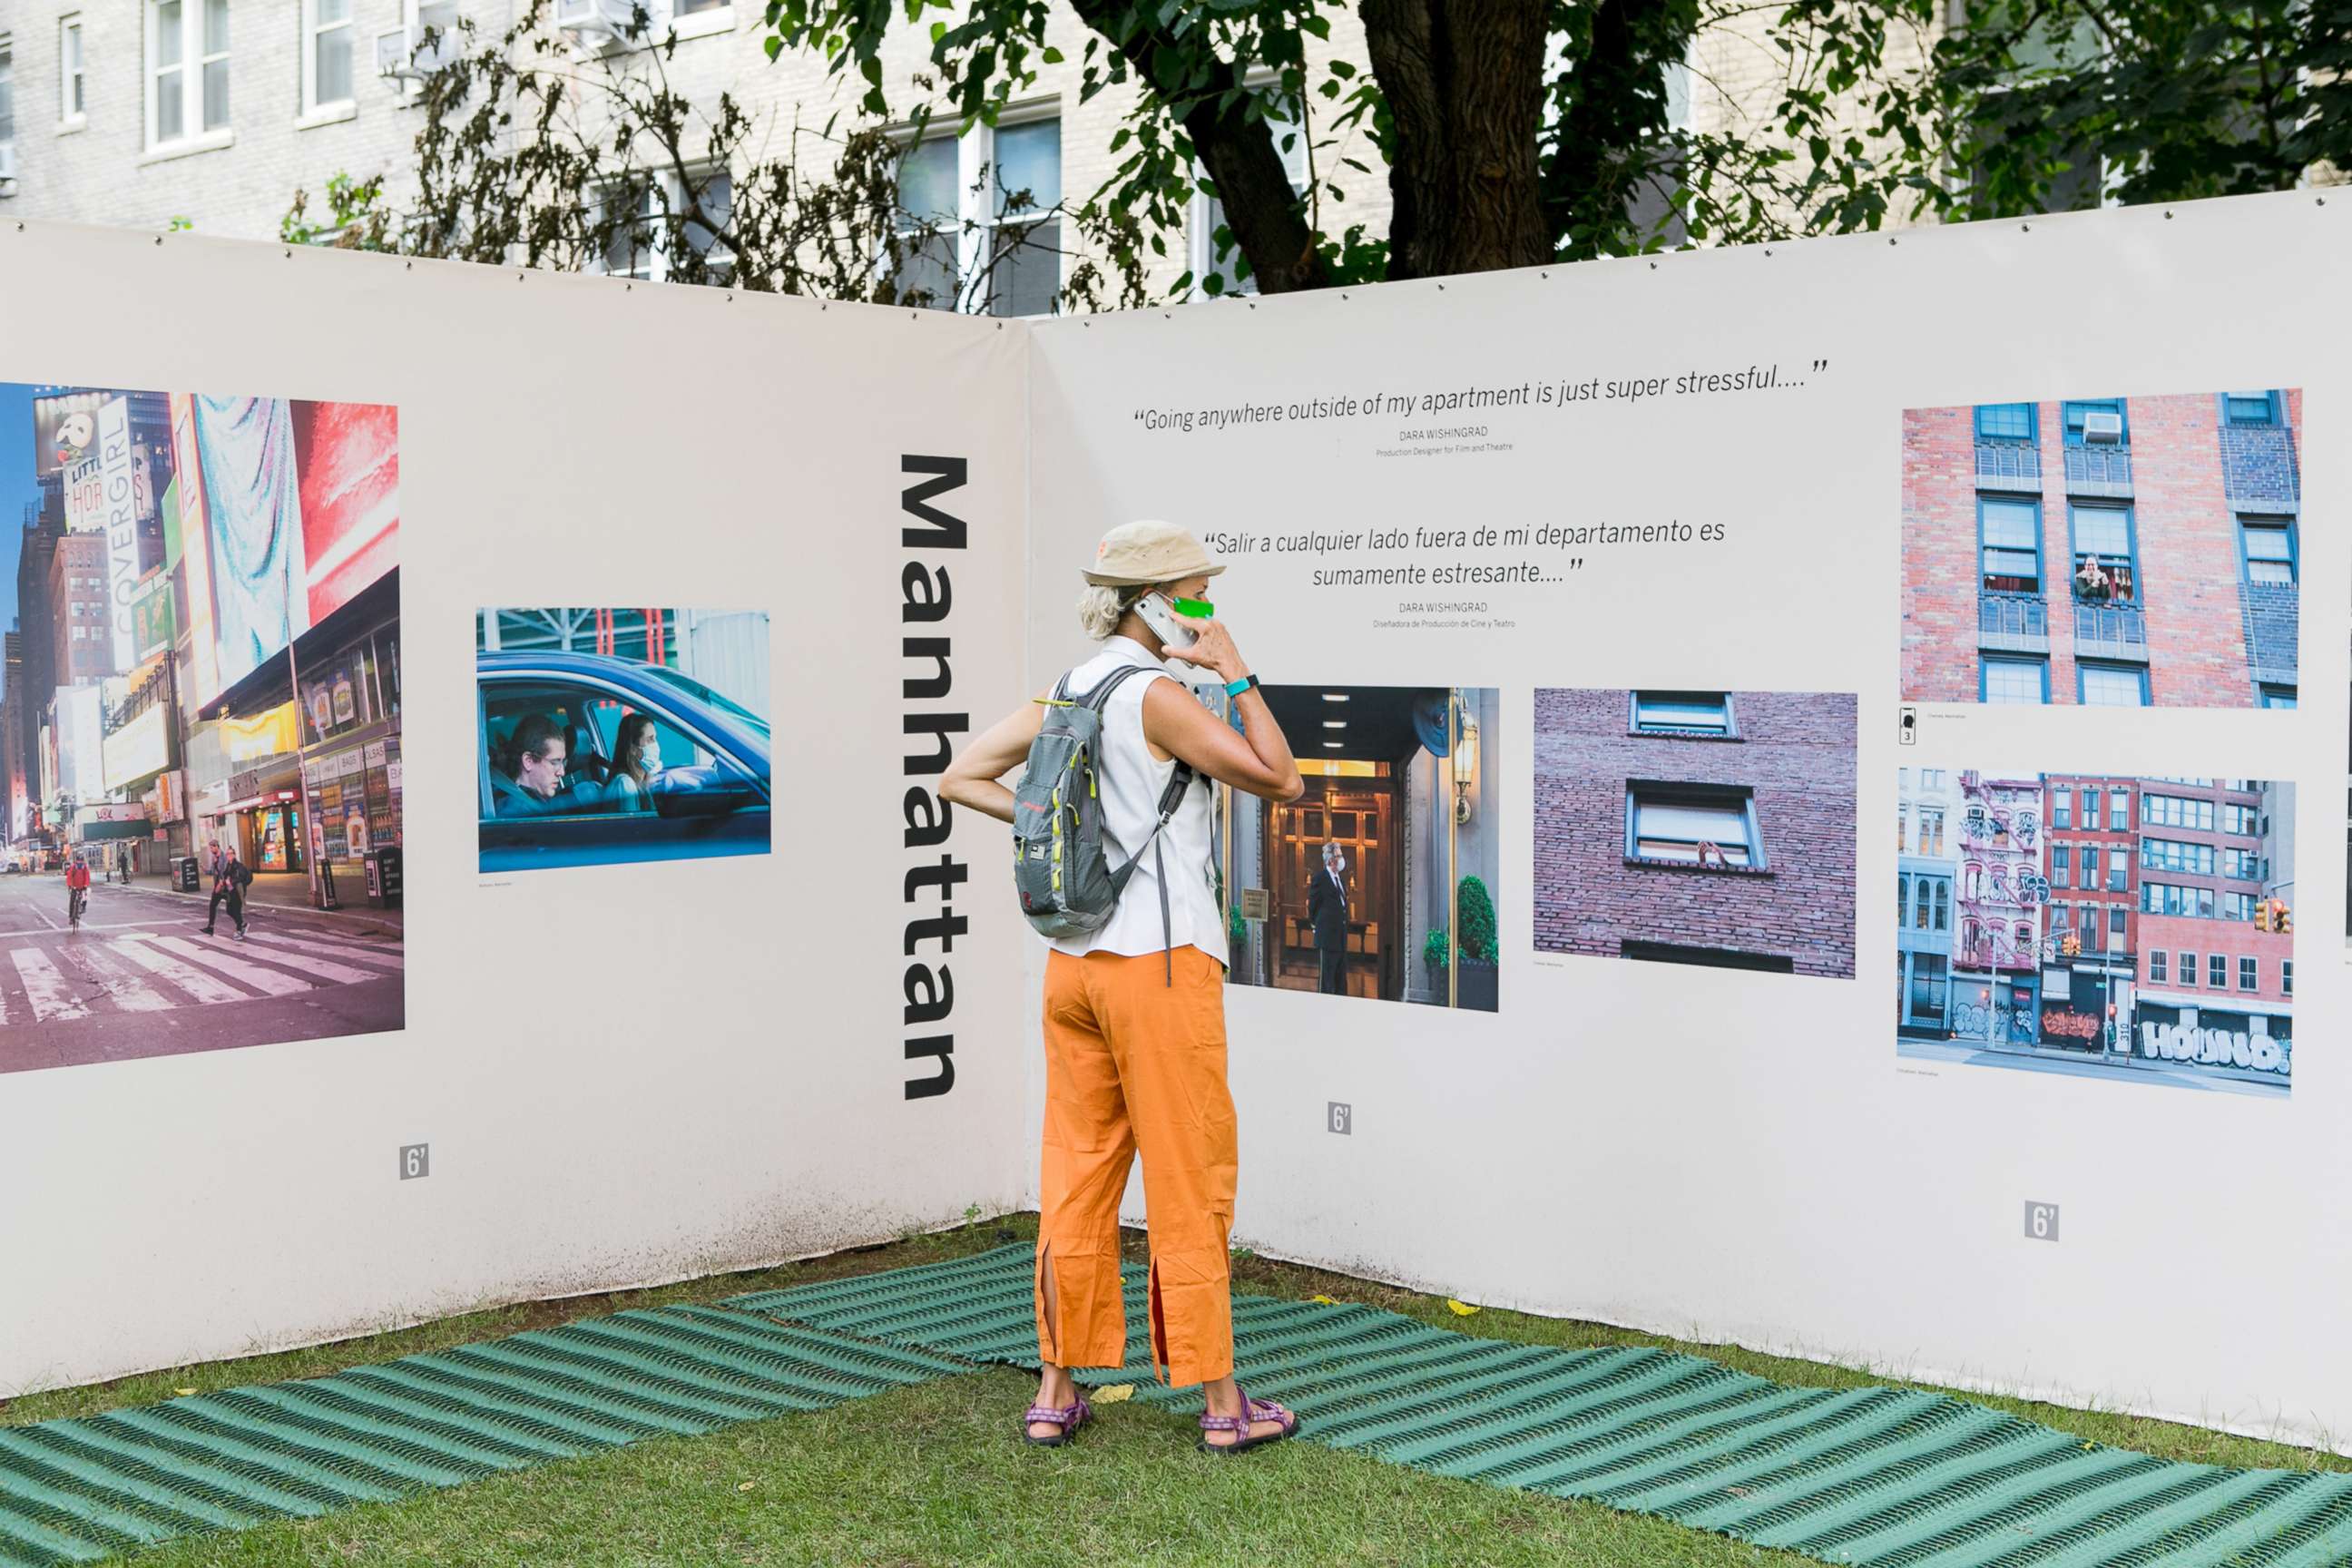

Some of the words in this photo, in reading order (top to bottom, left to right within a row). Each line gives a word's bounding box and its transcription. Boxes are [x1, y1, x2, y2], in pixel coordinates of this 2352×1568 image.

[1134, 409, 1194, 432] “Going
[1199, 403, 1283, 429] anywhere
[1289, 396, 1357, 420] outside
[1363, 393, 1383, 415] of
[1387, 397, 1416, 417] my
[1422, 383, 1530, 416] apartment
[1536, 382, 1553, 403] is
[1557, 377, 1600, 407] just
[1605, 378, 1670, 403] super
[1400, 430, 1424, 441] DARA
[1426, 426, 1487, 438] WISHINGRAD
[1376, 449, 1413, 457] Production
[1414, 446, 1444, 456] Designer
[1445, 446, 1454, 454] for
[1455, 445, 1470, 453] Film
[1472, 444, 1485, 452] and
[1486, 442, 1513, 451] Theatre
[104, 417, 133, 635] COVERGIRL
[1205, 533, 1256, 554] “Salir
[1260, 537, 1270, 552] a
[1277, 530, 1363, 555] cualquier
[1368, 528, 1408, 549] lado
[1416, 527, 1465, 548] fuera
[1473, 524, 1497, 546] de
[1504, 524, 1530, 545] mi
[1536, 519, 1692, 550] departamento
[1700, 524, 1725, 541] es
[1313, 564, 1426, 585] sumamente
[1400, 603, 1424, 612] DARA
[1426, 603, 1487, 612] WISHINGRAD
[1411, 620, 1420, 628] de
[1460, 620, 1469, 628] de
[1471, 620, 1486, 628] Cine
[1494, 620, 1516, 628] Teatro
[1905, 732, 1910, 740] 3
[902, 455, 970, 1100] Manhattan
